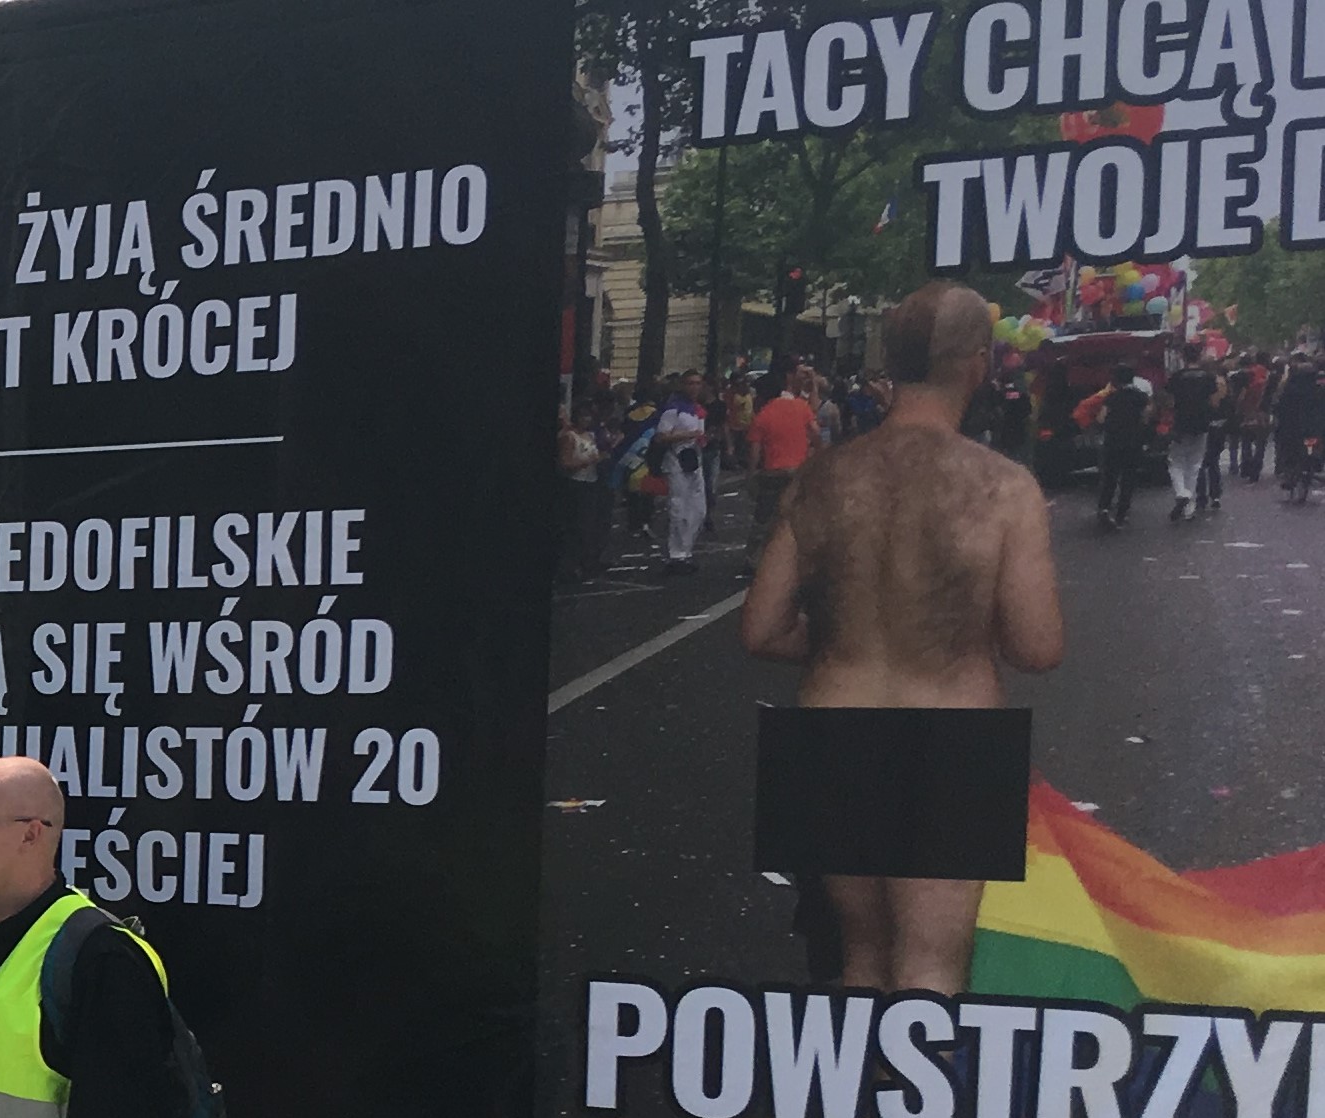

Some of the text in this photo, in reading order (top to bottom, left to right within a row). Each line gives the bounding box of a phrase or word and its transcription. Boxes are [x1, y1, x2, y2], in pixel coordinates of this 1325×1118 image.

[690, 11, 936, 140] TACY
[963, 0, 1264, 119] CHCĄ
[15, 190, 157, 296] ŻYJĄ
[181, 164, 488, 270] ŚREDNIO
[923, 134, 1256, 267] TWOJE
[52, 280, 299, 385] KRÓCEJ
[32, 619, 127, 716] SIĘ
[149, 595, 396, 695] WŚRÓD
[351, 727, 441, 806] 20
